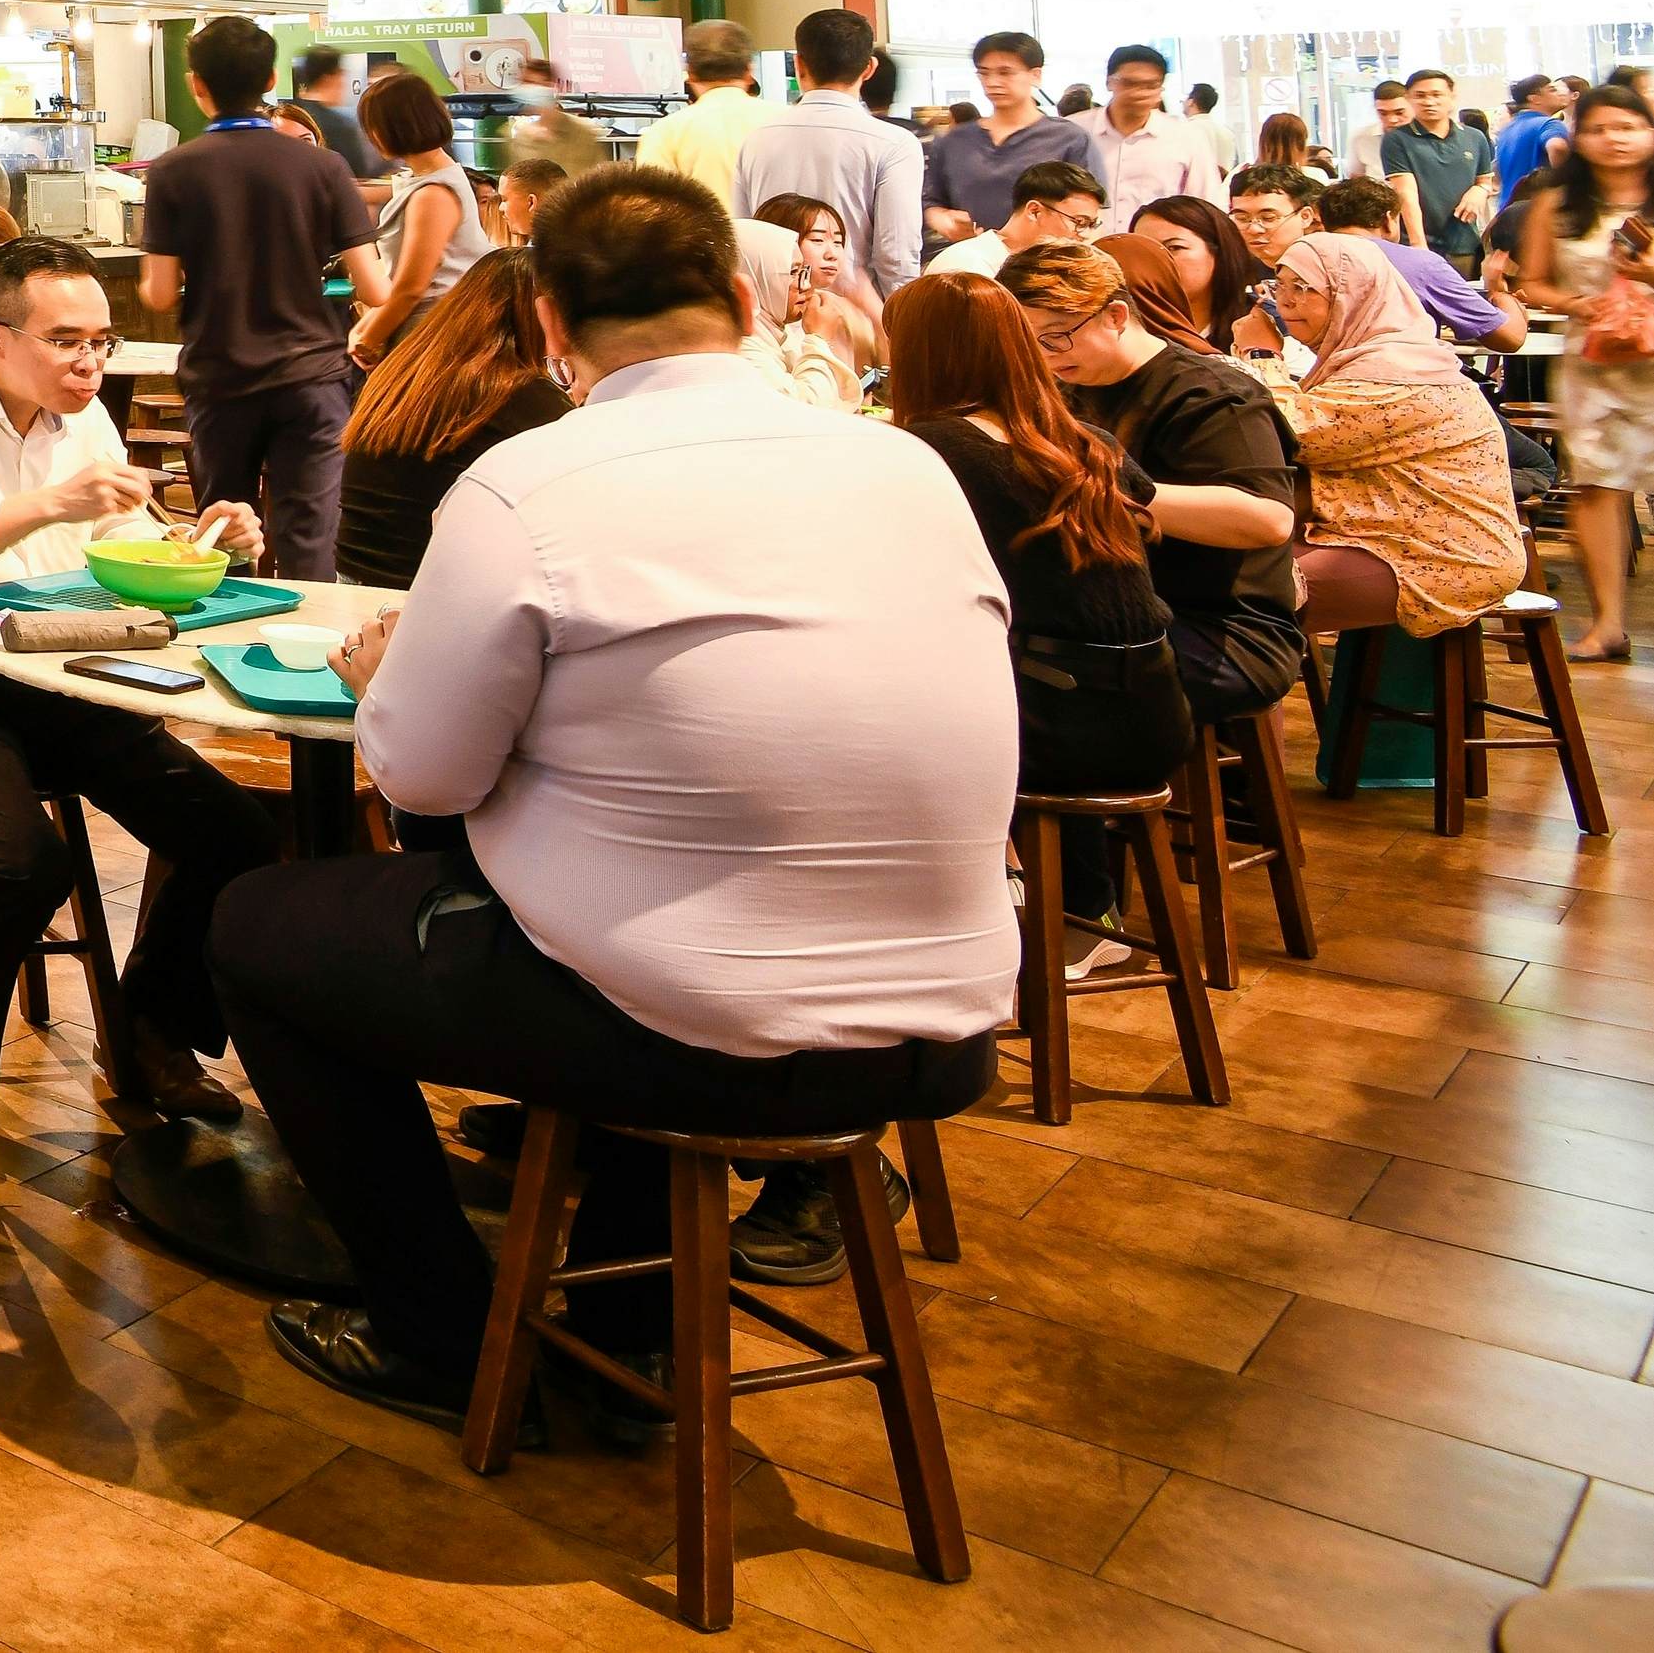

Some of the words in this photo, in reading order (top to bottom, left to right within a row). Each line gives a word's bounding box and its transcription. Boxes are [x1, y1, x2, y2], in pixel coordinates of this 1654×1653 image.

[325, 25, 369, 37] HALAL
[374, 23, 411, 35] TRAY
[416, 21, 475, 35] RETURN
